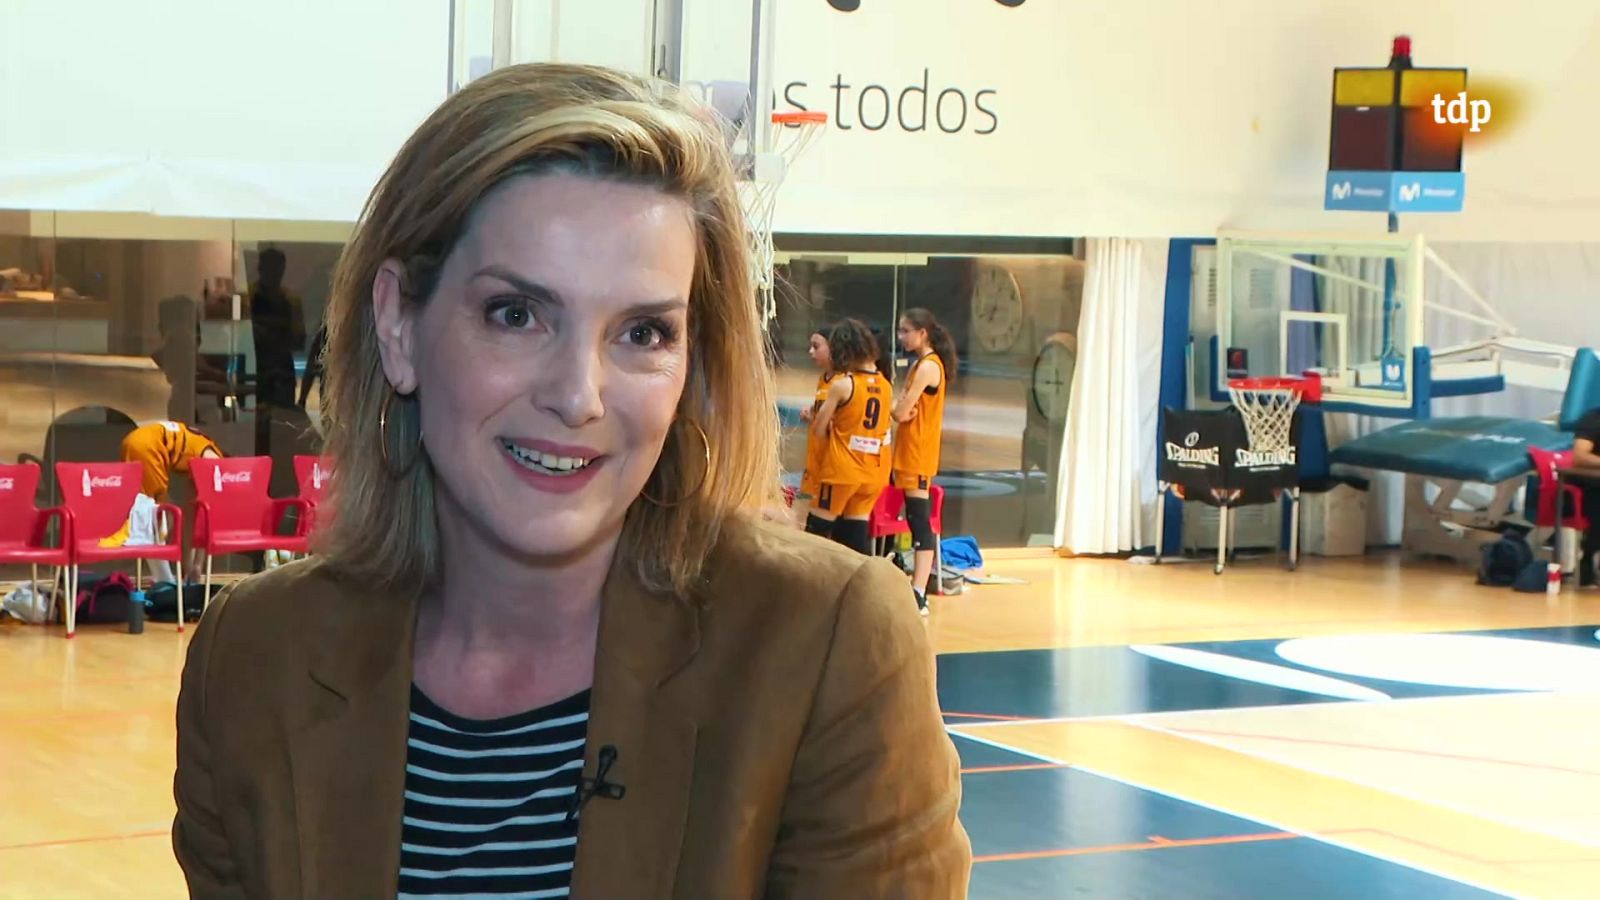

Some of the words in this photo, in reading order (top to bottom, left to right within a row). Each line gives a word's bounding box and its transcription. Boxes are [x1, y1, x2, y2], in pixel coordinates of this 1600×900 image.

[830, 67, 998, 135] todos
[863, 397, 880, 429] 9
[1165, 441, 1219, 465] SPALDING
[1234, 446, 1296, 467] SPALDING
